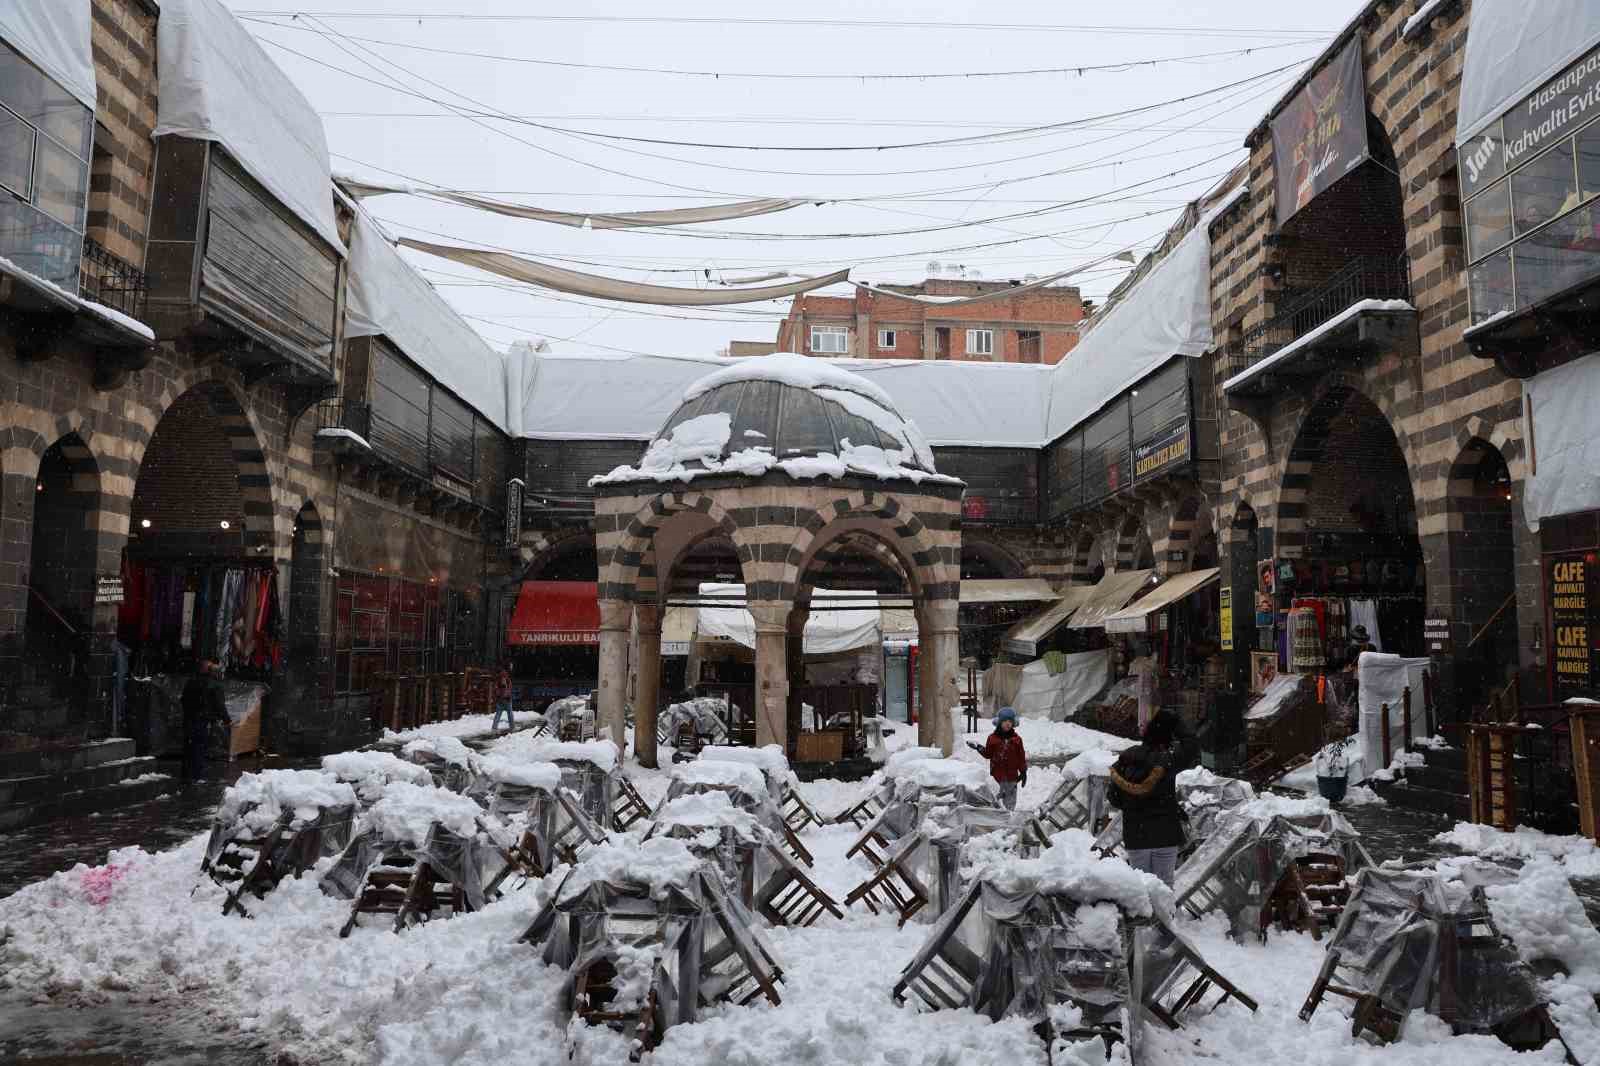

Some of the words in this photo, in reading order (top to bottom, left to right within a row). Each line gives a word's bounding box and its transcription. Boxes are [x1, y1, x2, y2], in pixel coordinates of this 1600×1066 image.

[1505, 108, 1567, 162] Kahvaltı
[1466, 136, 1496, 182] Jan
[1554, 562, 1584, 581] CAFE
[1557, 626, 1586, 646] CAFE
